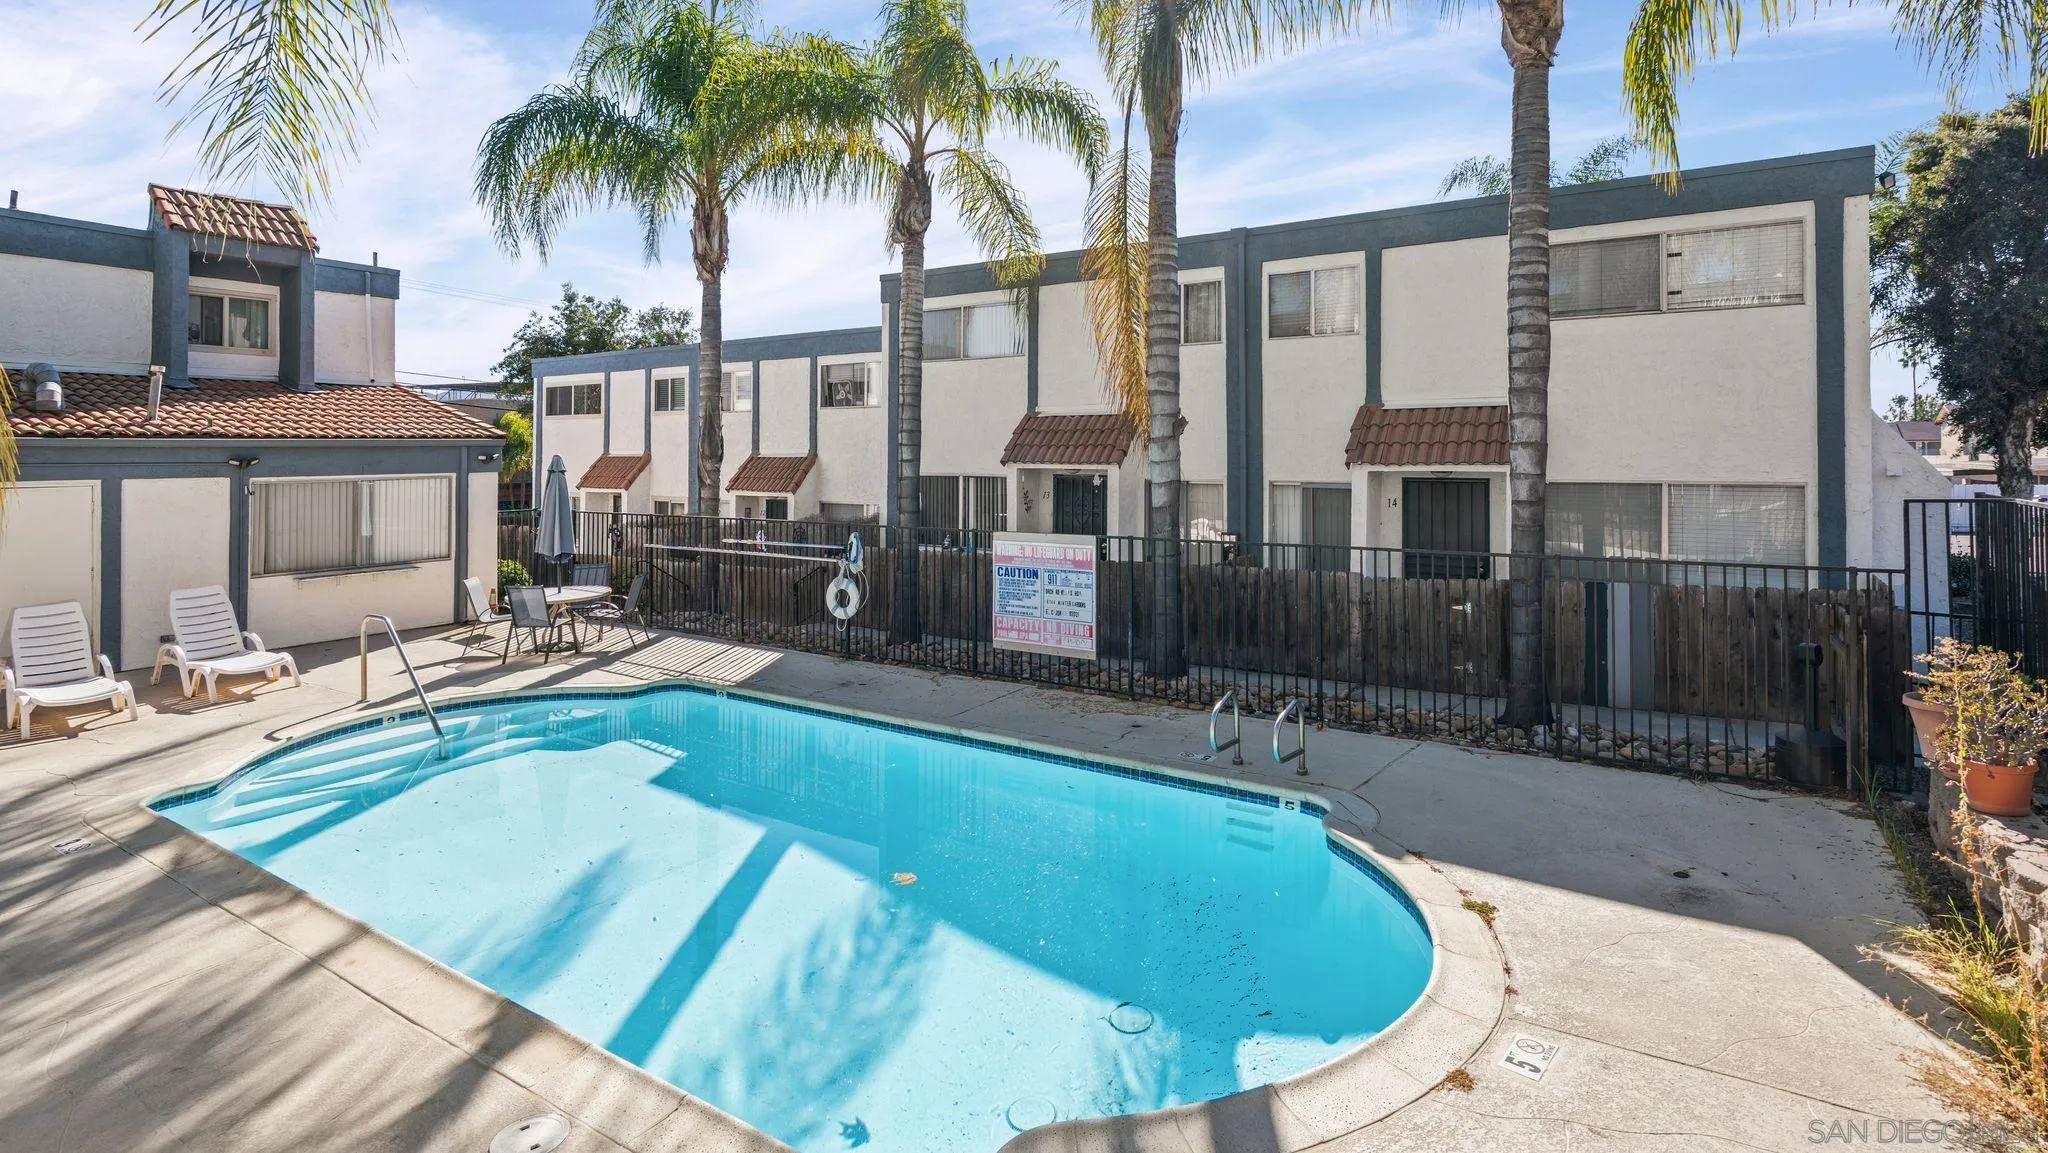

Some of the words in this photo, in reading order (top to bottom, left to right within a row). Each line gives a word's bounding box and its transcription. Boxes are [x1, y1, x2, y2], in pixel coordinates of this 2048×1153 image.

[1387, 497, 1398, 508] 14
[1065, 547, 1074, 561] ON
[1075, 548, 1092, 562] DUTY
[997, 566, 1039, 580] CAUTION
[1047, 574, 1058, 586] 911
[996, 616, 1040, 633] CAPACITY
[1046, 622, 1057, 634] NO
[1061, 624, 1090, 637] DIVING
[1284, 800, 1295, 811] 5
[1504, 1056, 1541, 1074] 5
